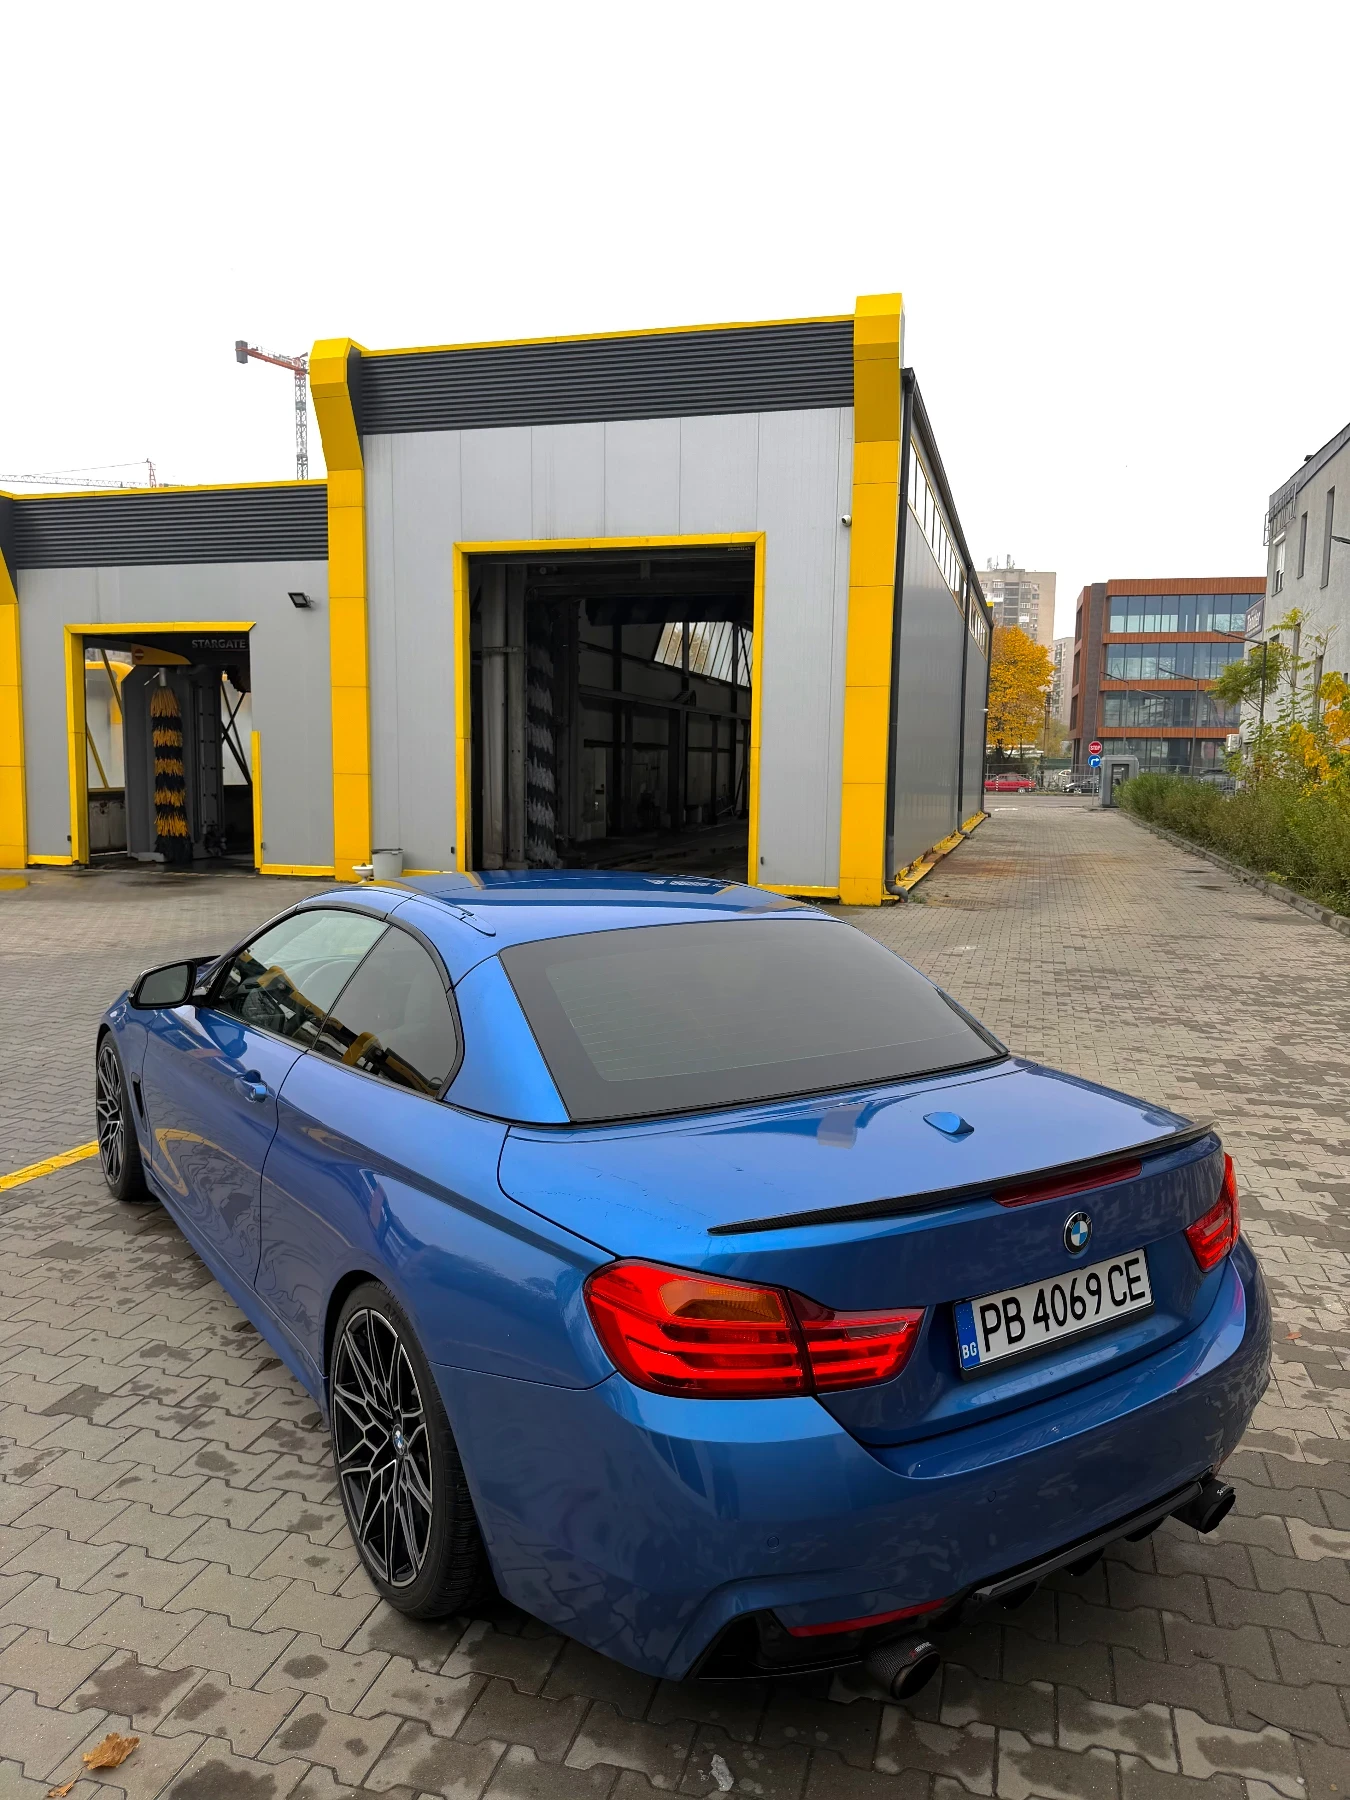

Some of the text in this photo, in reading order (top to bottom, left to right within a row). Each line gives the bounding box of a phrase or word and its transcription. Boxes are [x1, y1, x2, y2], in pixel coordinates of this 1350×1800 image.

[192, 639, 246, 649] STARGATE
[1068, 1213, 1092, 1229] BMW
[979, 1257, 1146, 1353] PB 4069 CE
[961, 1341, 977, 1360] BG
